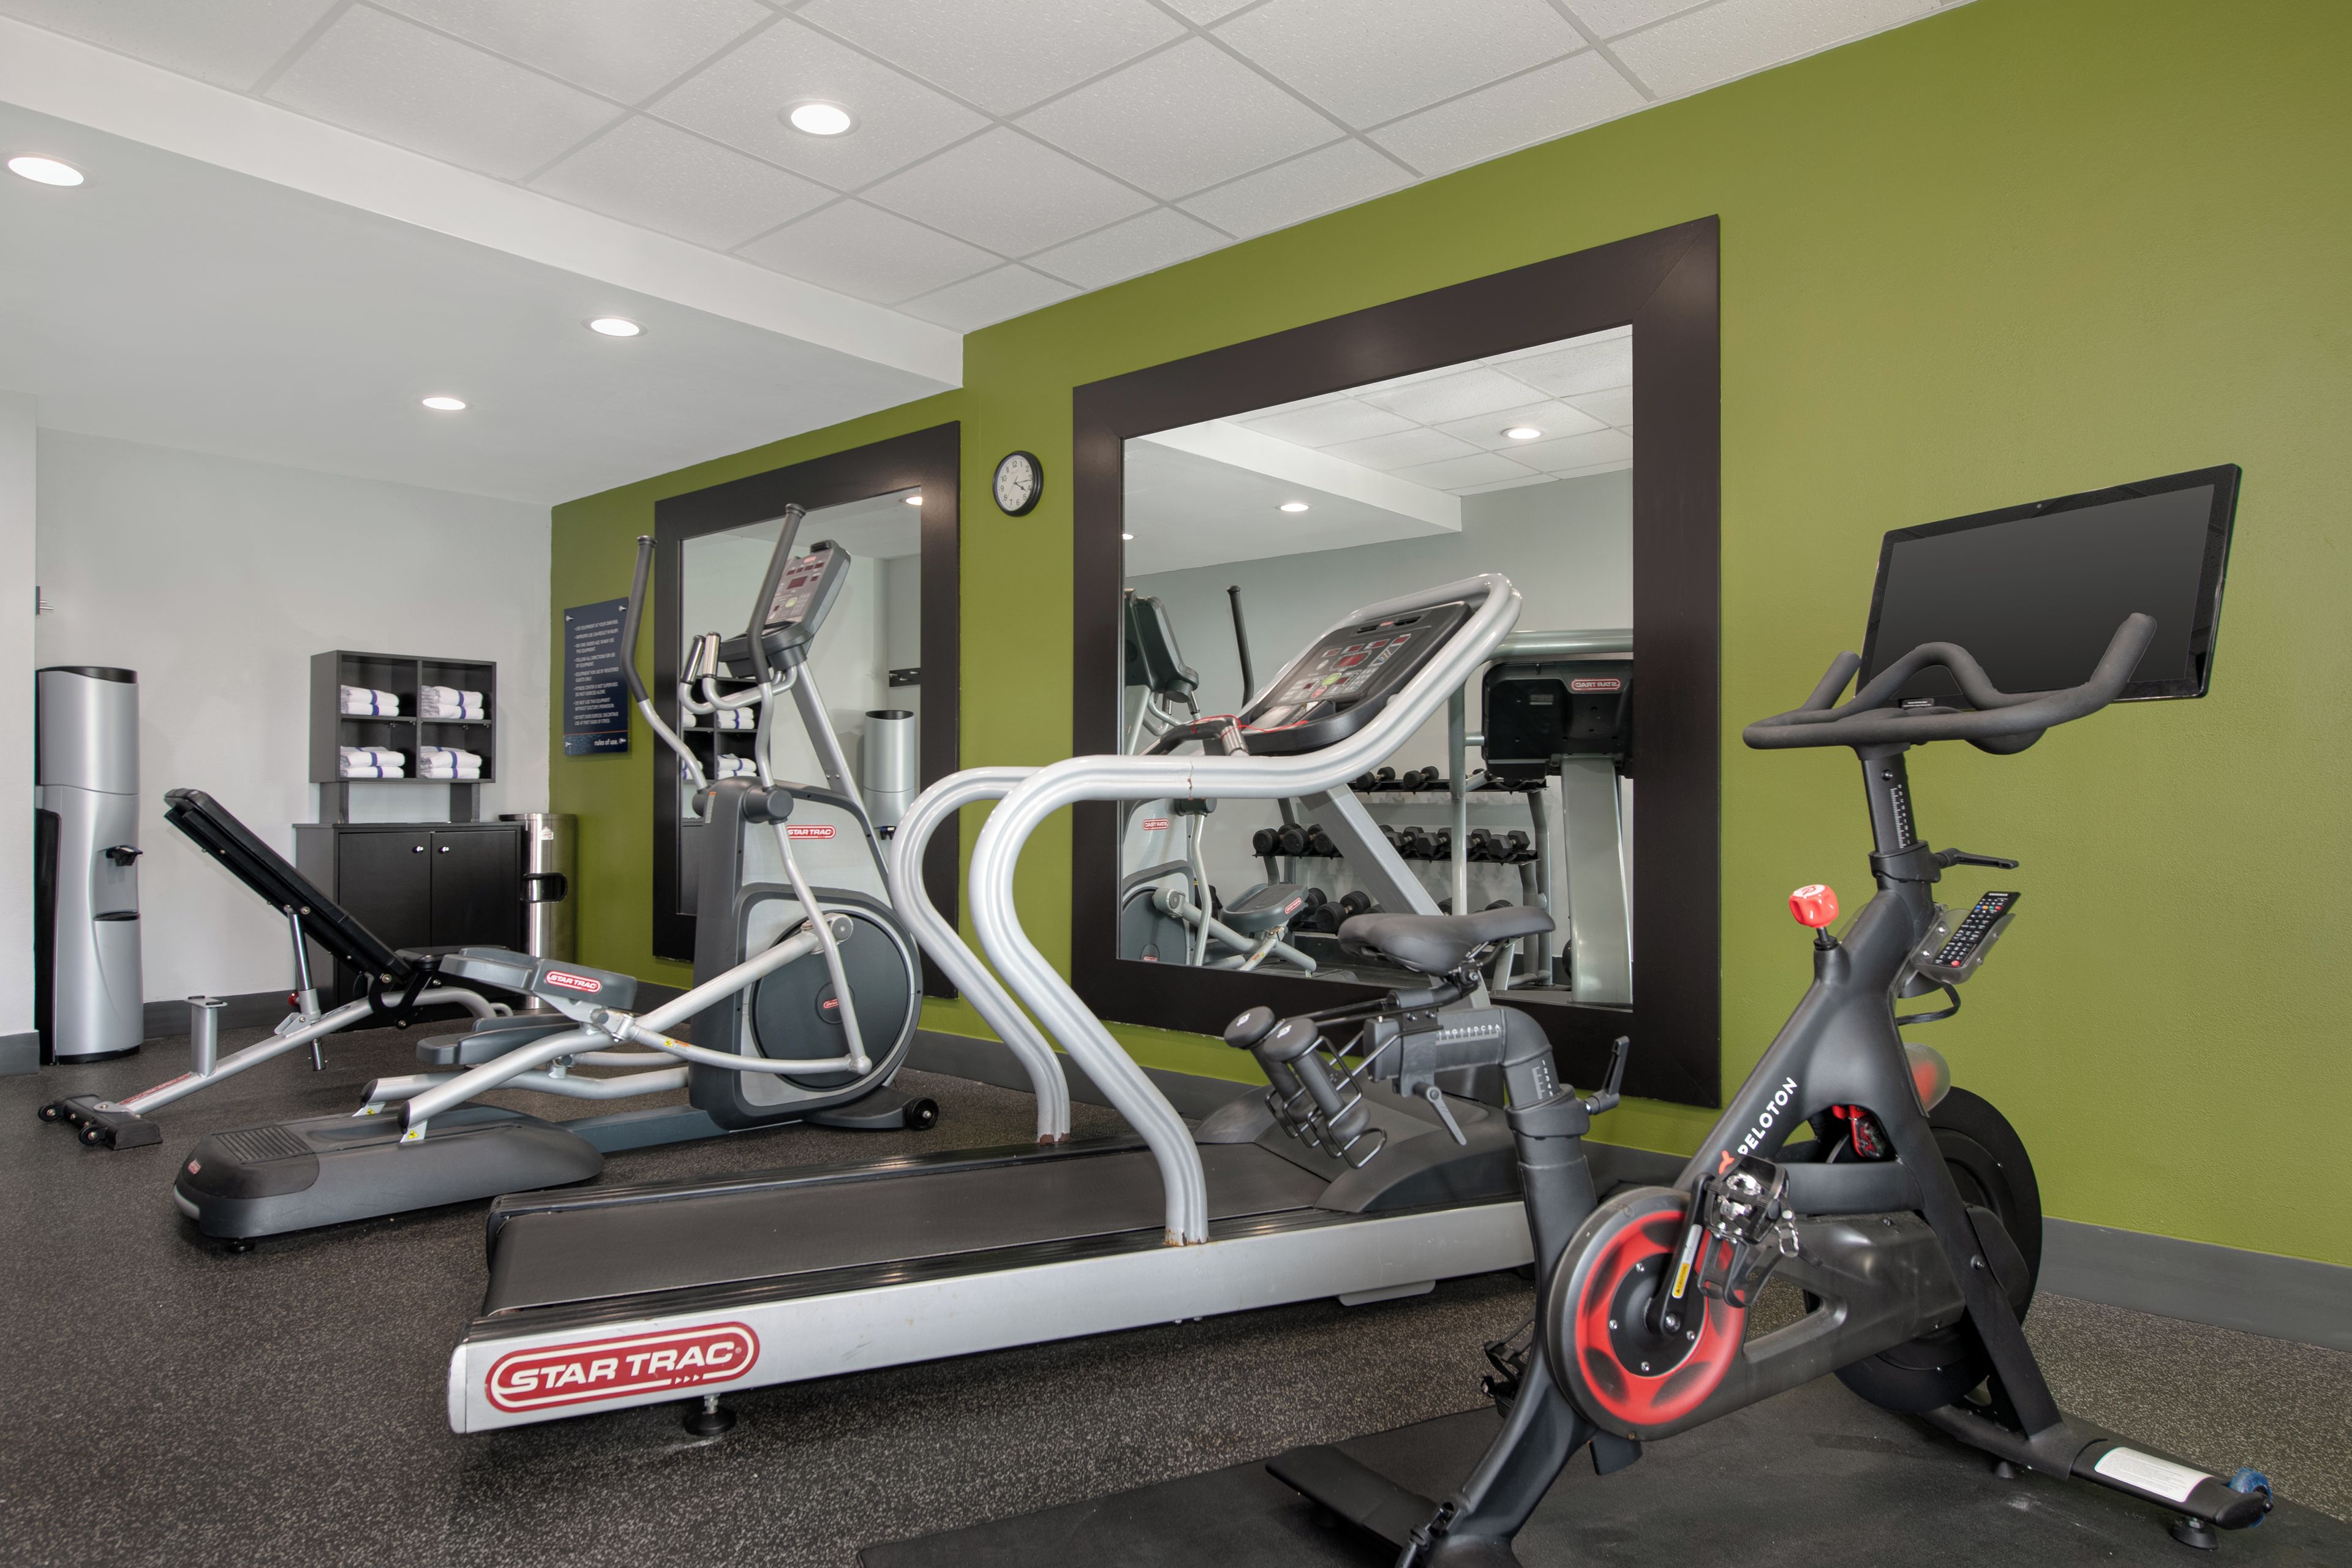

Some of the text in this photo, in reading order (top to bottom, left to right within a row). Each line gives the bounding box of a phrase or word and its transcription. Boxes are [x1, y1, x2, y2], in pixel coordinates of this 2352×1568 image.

[550, 974, 597, 989] STAR TRAC
[1737, 1077, 1798, 1155] PELOTON
[510, 1341, 735, 1392] STAR TRAC
